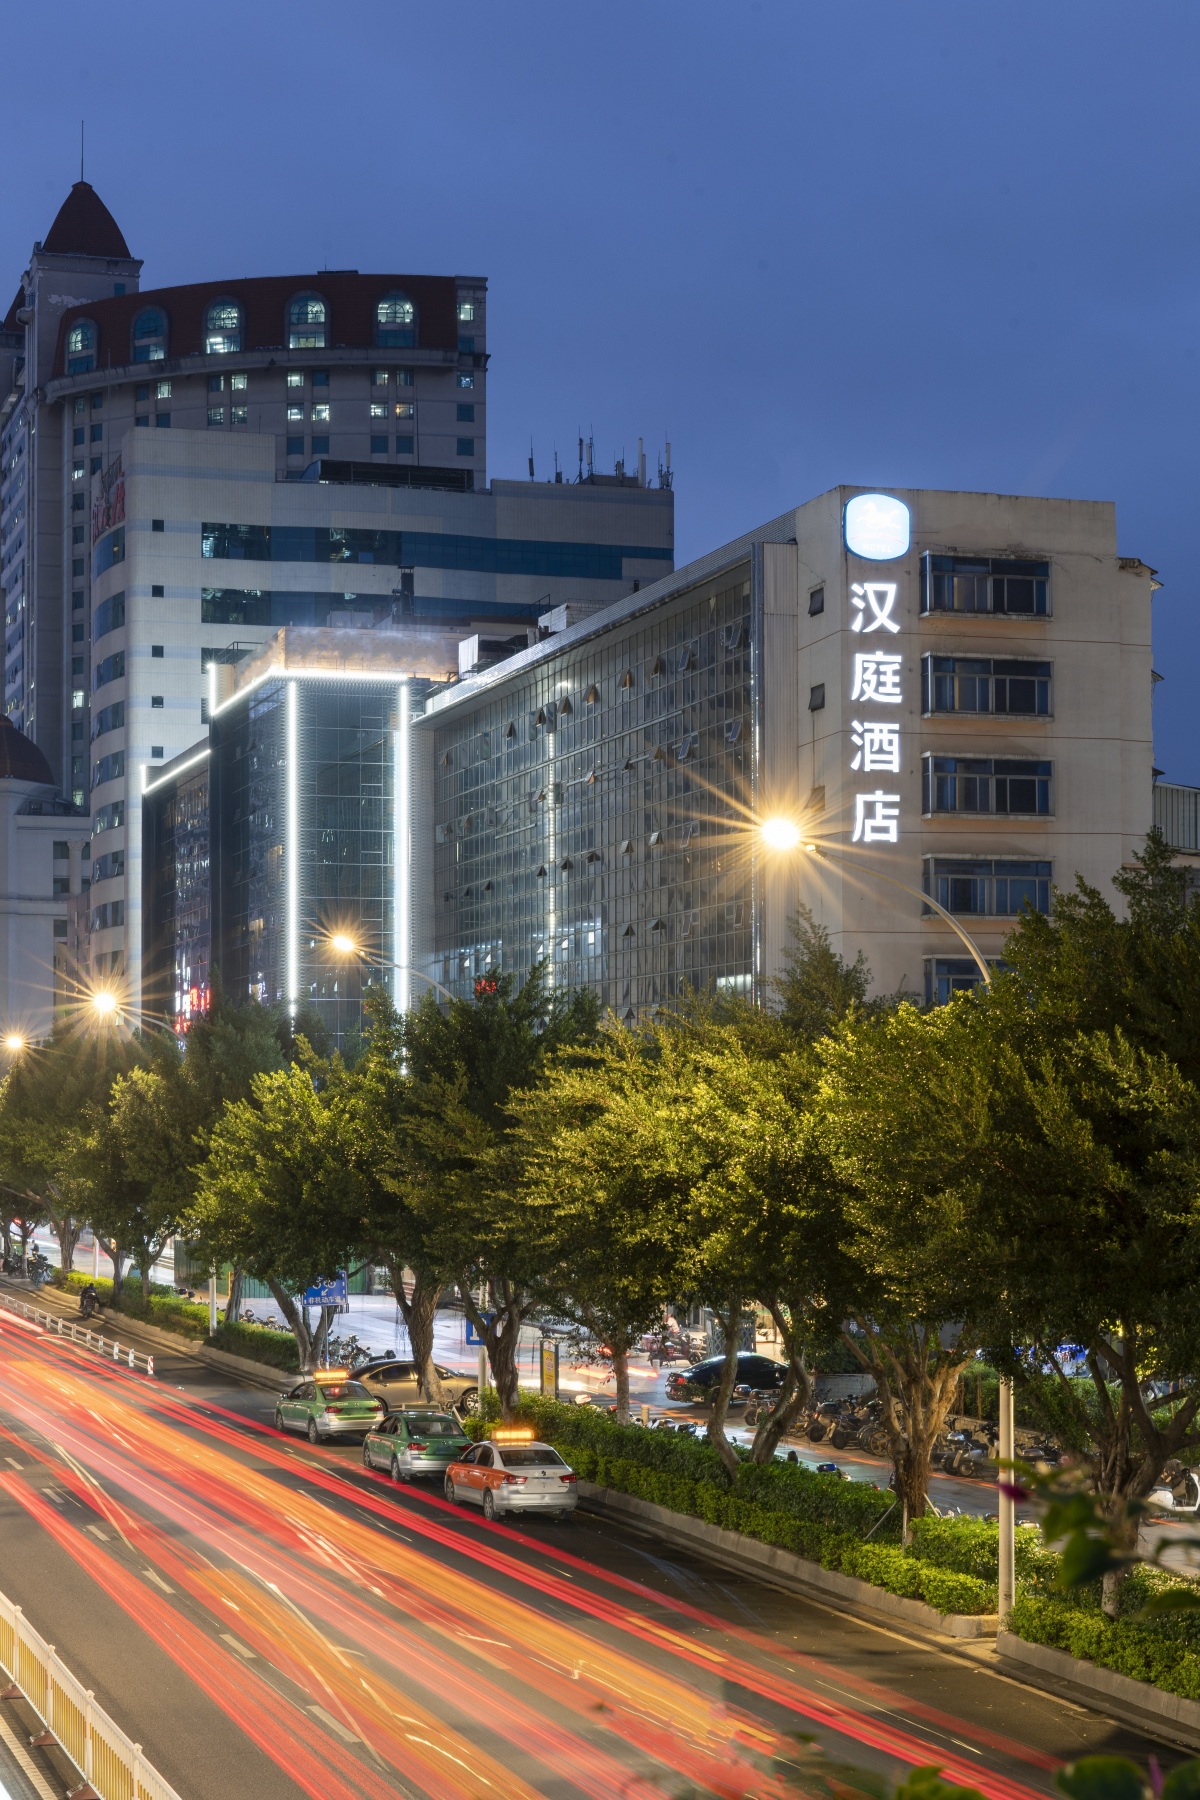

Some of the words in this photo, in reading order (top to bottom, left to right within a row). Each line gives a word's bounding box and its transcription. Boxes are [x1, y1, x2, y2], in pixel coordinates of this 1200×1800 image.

[862, 543, 892, 553] HOTEL
[850, 582, 902, 843] 汉庭酒店
